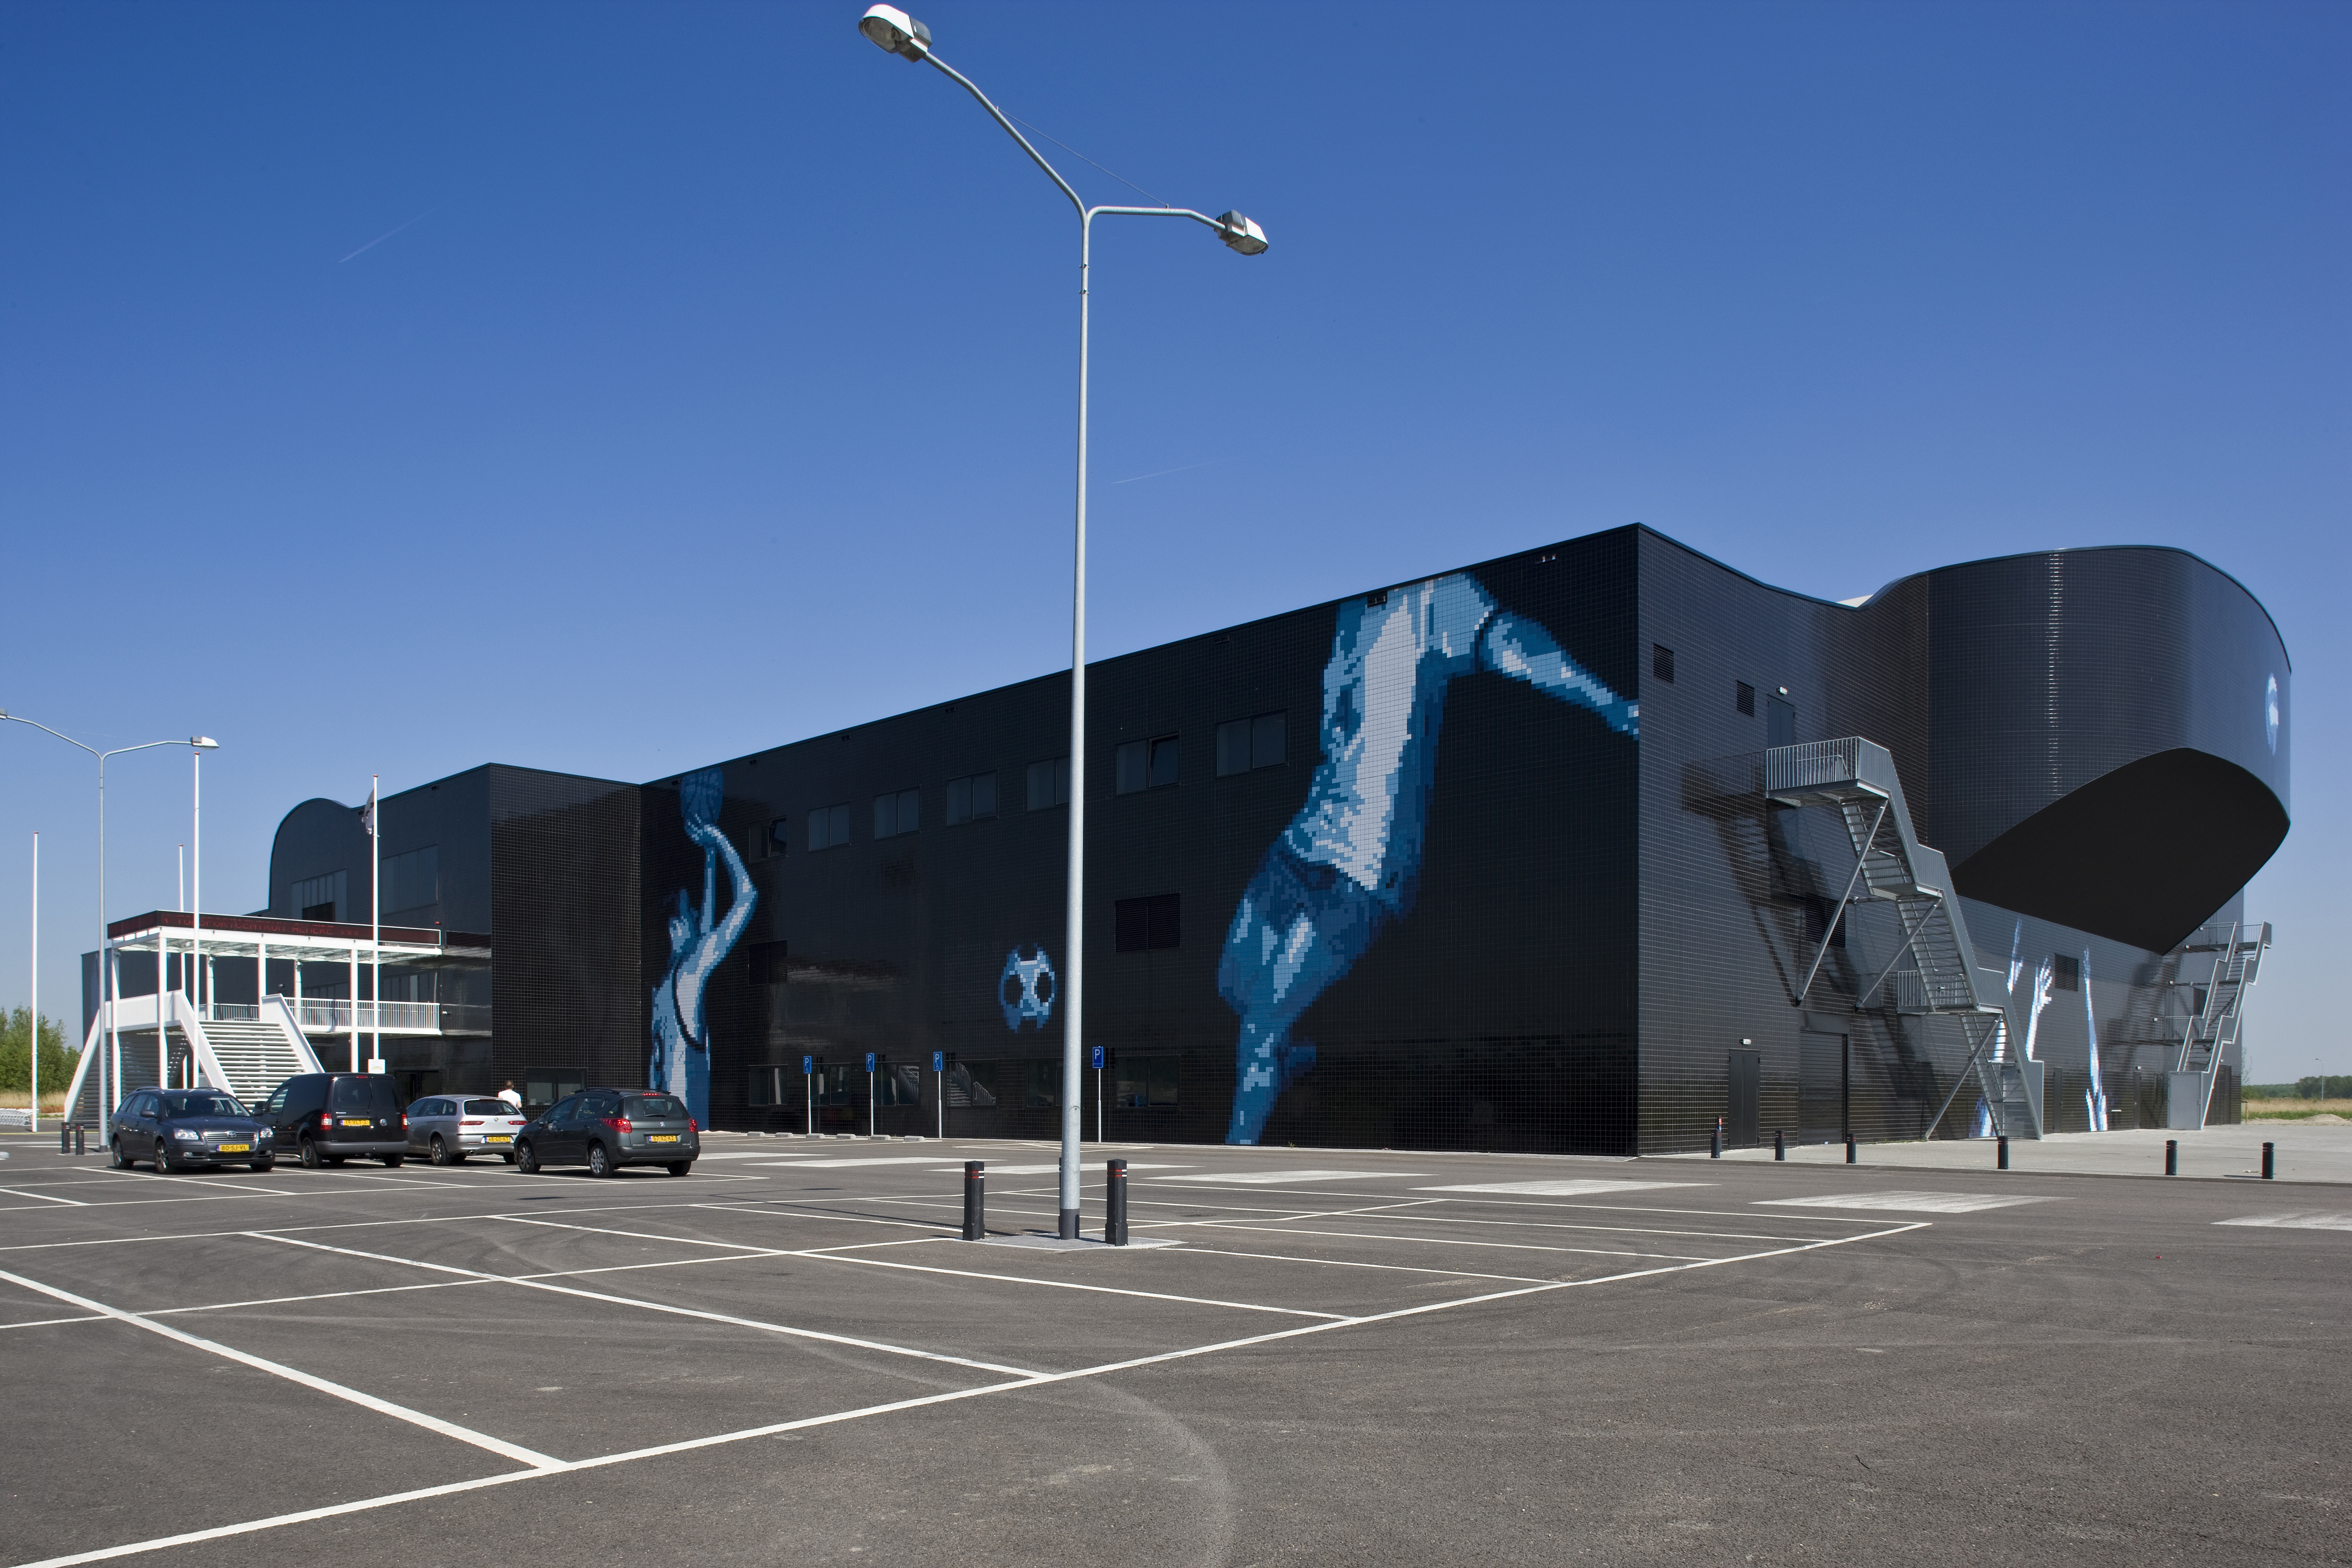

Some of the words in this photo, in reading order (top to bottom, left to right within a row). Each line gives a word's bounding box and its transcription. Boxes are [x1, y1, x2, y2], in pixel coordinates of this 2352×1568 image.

[935, 1053, 939, 1063] P
[1095, 1049, 1100, 1060] P
[805, 1057, 809, 1066] P
[868, 1055, 872, 1064] P
